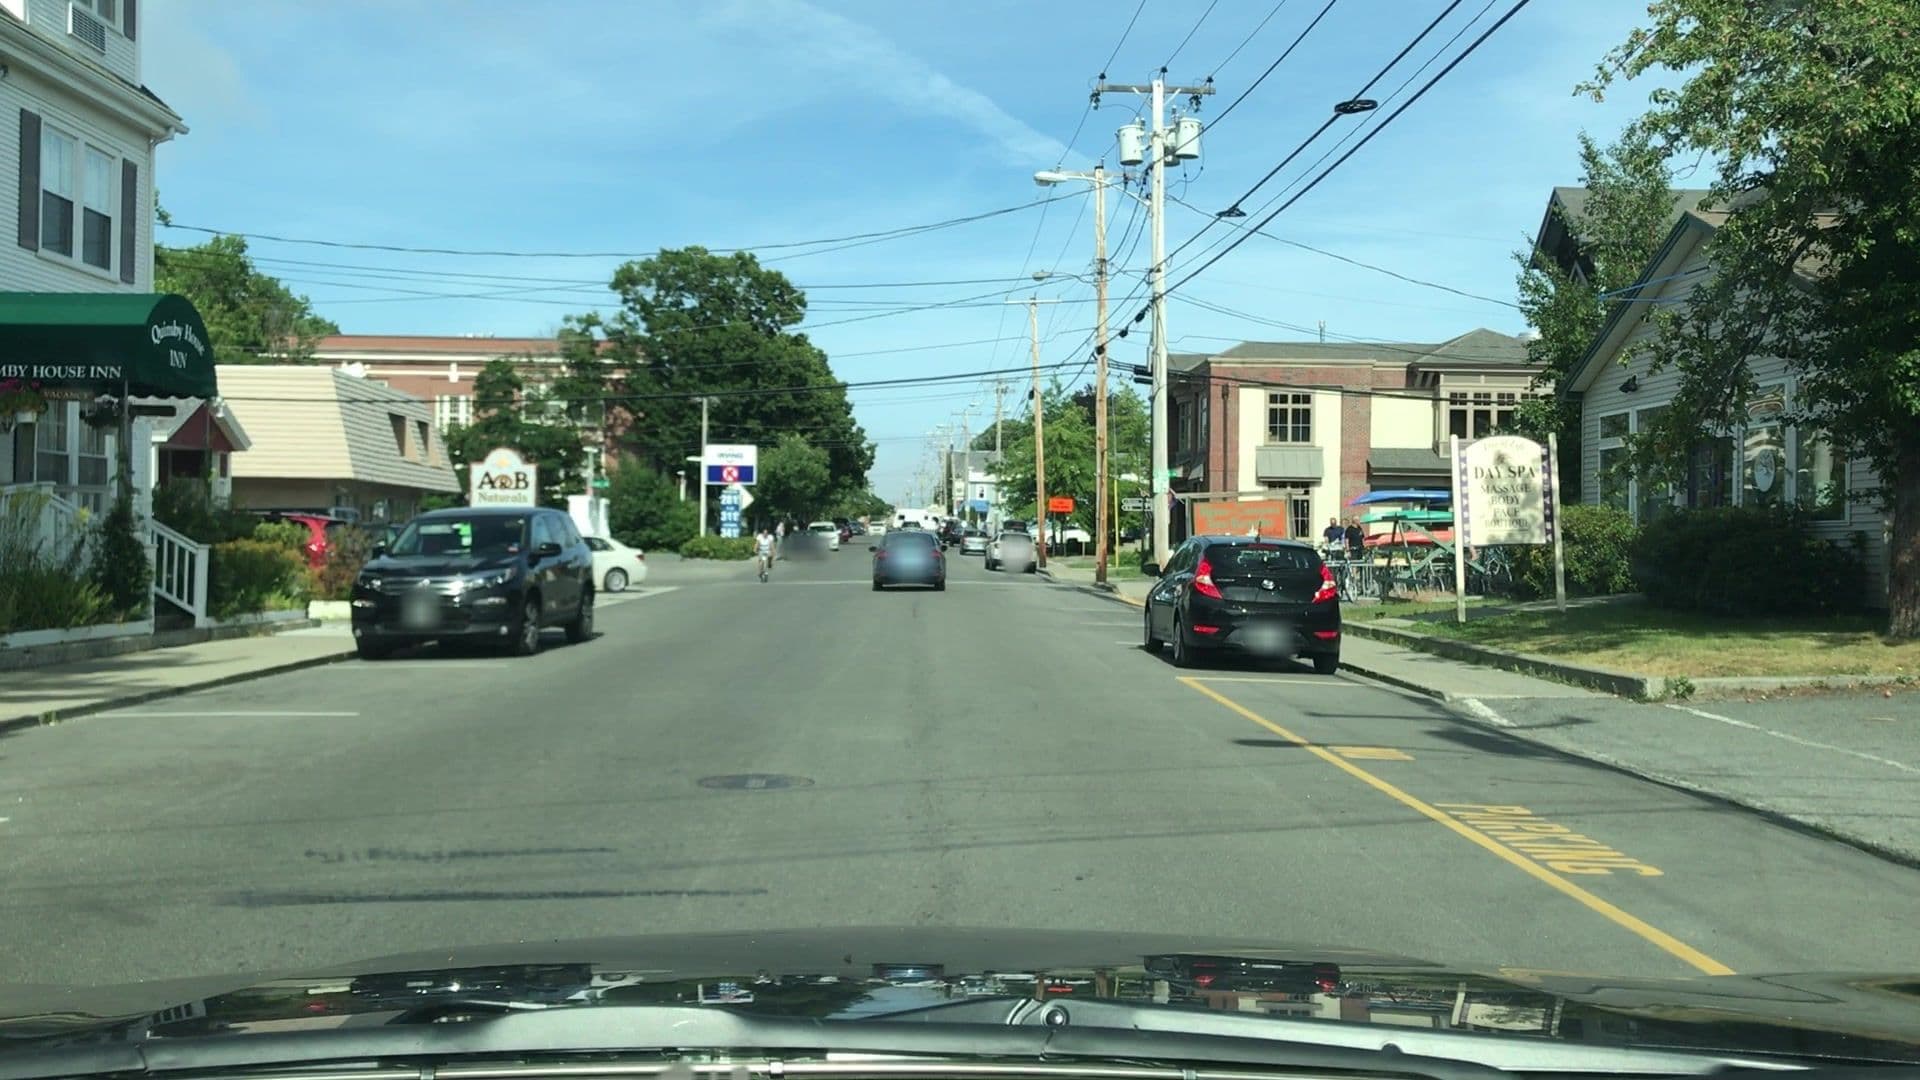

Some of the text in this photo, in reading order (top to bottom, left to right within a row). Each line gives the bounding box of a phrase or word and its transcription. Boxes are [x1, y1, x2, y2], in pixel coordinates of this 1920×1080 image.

[170, 349, 188, 368] INN
[32, 364, 86, 378] HOUSE
[90, 364, 122, 378] INN
[1474, 464, 1536, 479] DAY SPA
[1481, 483, 1532, 494] MASSAGE
[478, 492, 529, 503] Naturals
[1491, 495, 1520, 505] BODY
